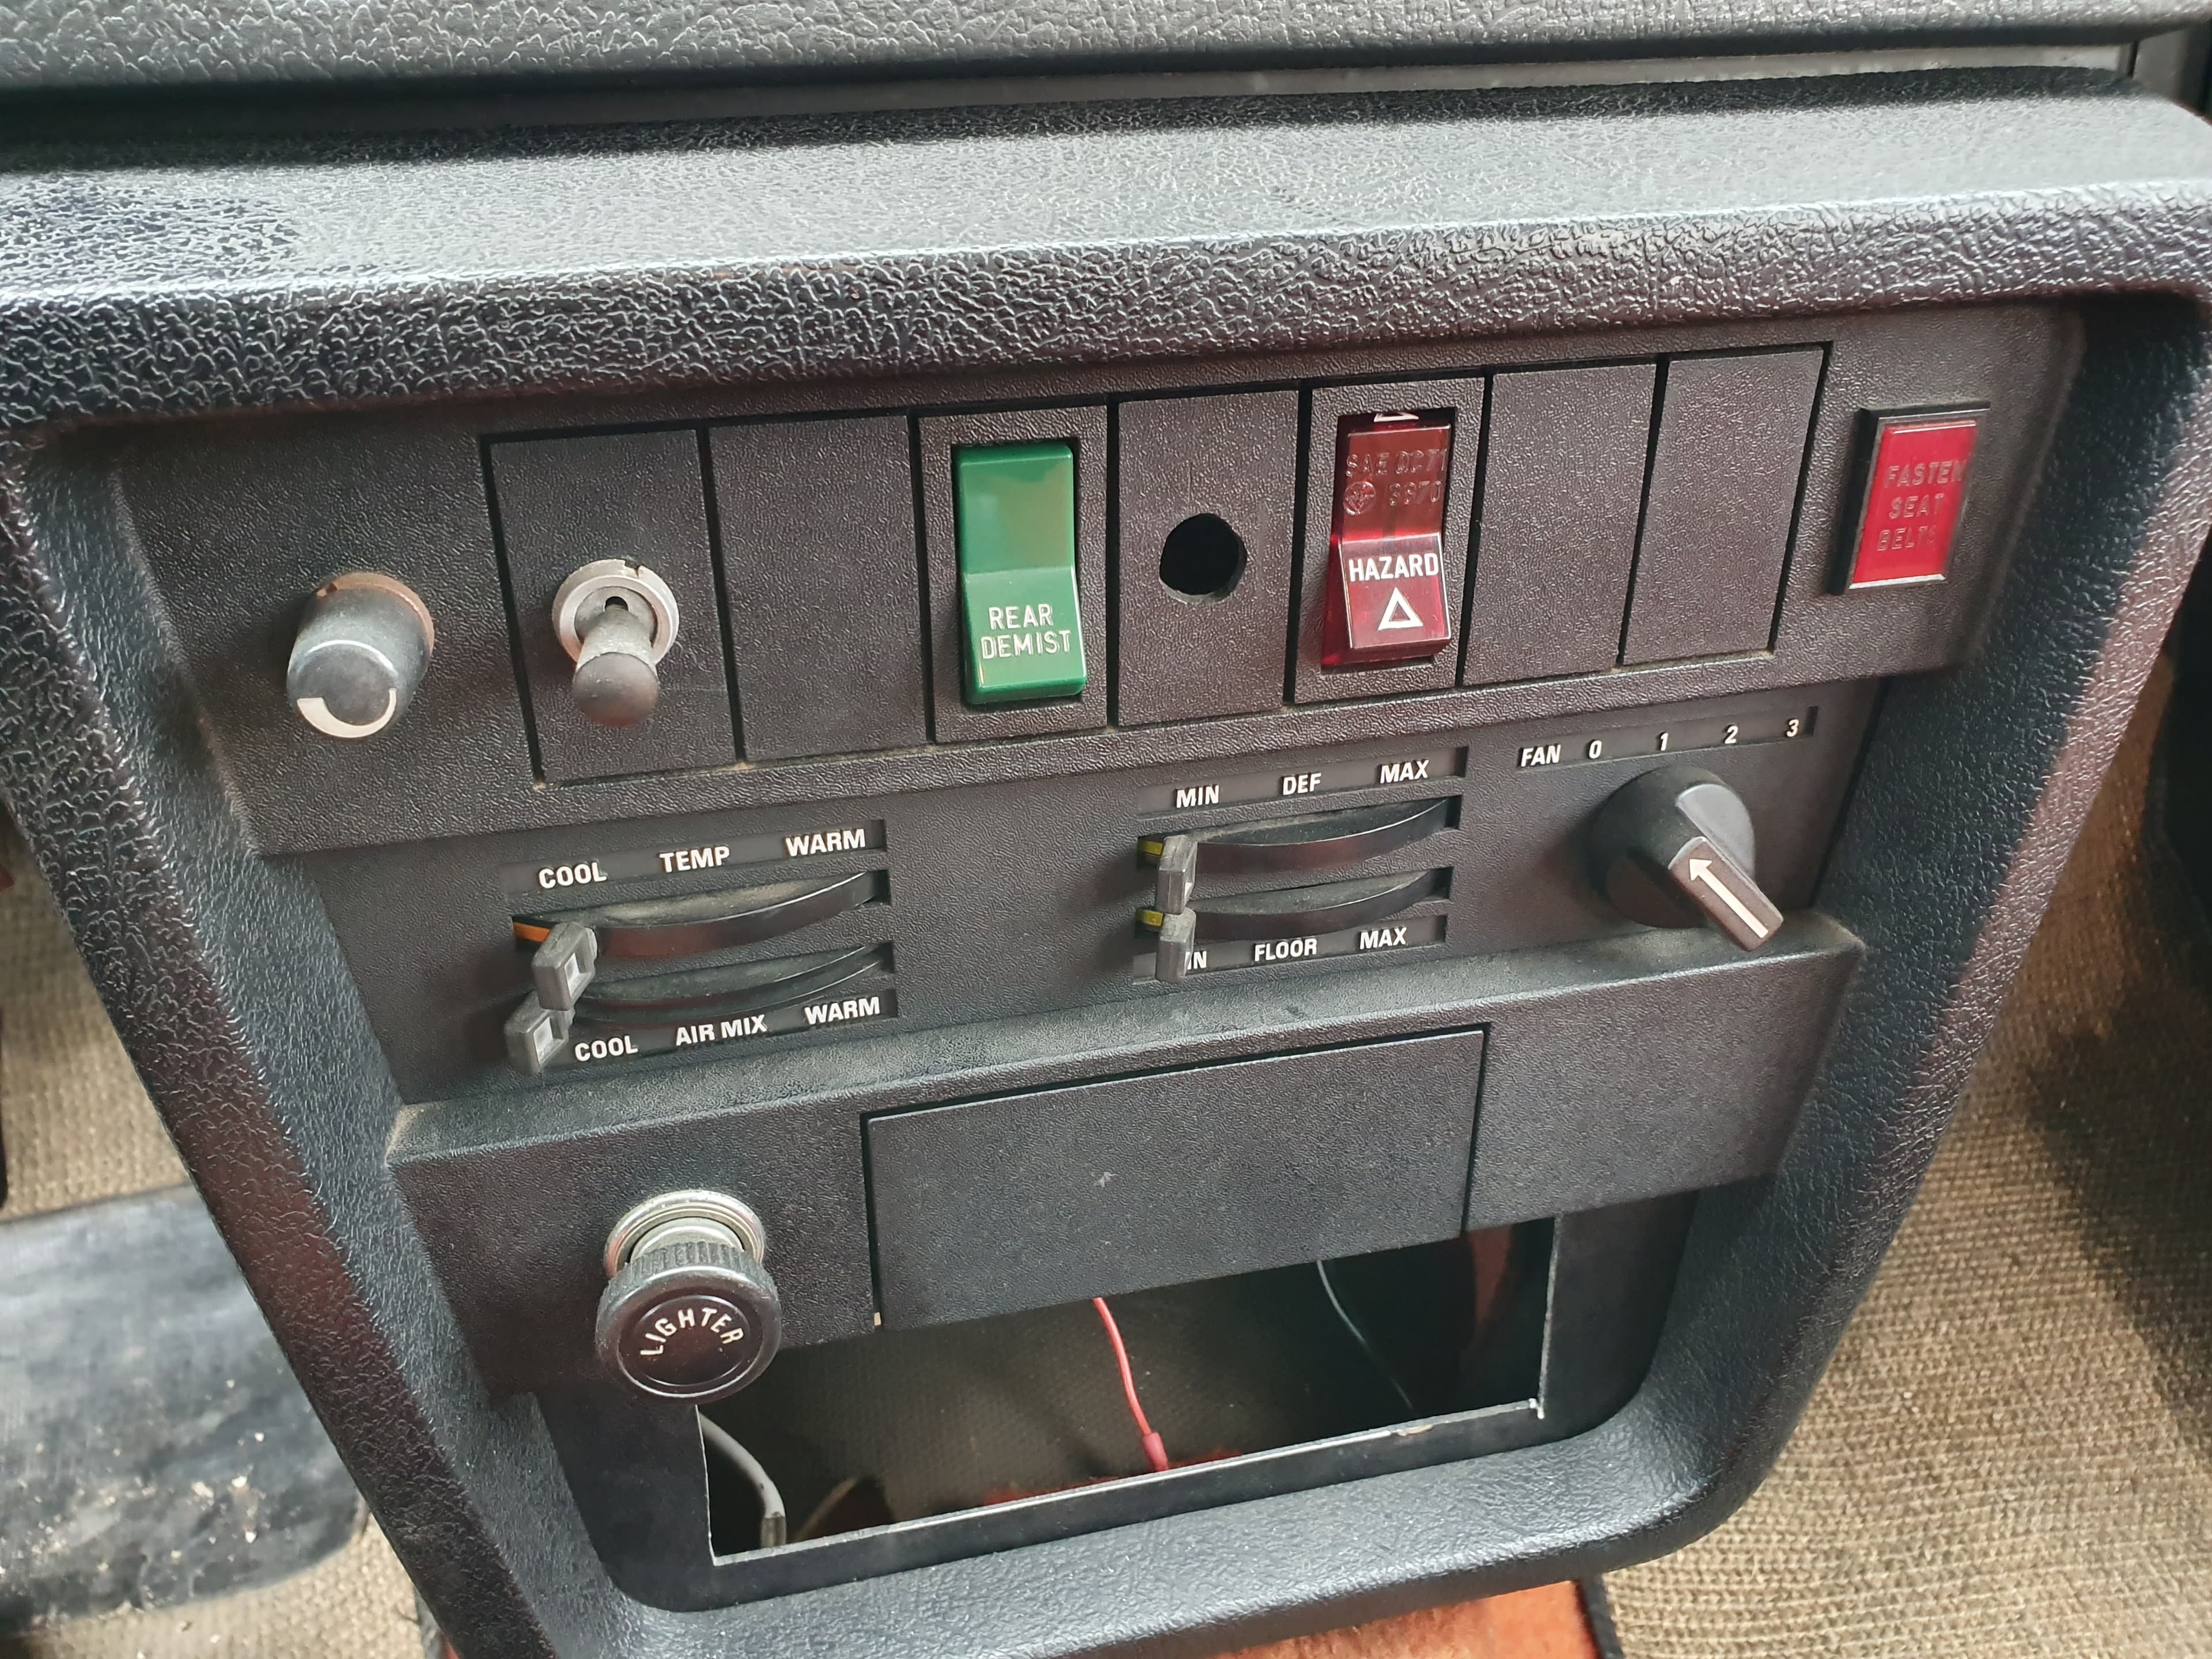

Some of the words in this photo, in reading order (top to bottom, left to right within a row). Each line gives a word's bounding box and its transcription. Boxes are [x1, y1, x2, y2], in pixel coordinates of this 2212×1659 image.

[1346, 452, 1390, 477] SAE
[1884, 460, 1967, 488] FASTEN
[1889, 493, 1945, 520] SEAT
[1877, 525, 1936, 551] BELTS
[1348, 552, 1440, 582] HAZARD
[988, 603, 1054, 630] REAR
[980, 630, 1071, 660] DEMIST
[1521, 744, 1561, 767] FAN
[1589, 740, 1602, 759] 0
[1661, 733, 1669, 751] 1
[1725, 725, 1738, 744] 2
[1787, 719, 1799, 737] 3
[1176, 785, 1219, 808] MIN
[1283, 772, 1321, 796] DEF
[1380, 760, 1429, 784] MAX
[539, 862, 607, 889] COOL
[659, 846, 730, 873] TEMP
[786, 828, 866, 857] WARM
[1255, 938, 1317, 962] FLOOR
[1359, 927, 1407, 950] MAX
[575, 1035, 638, 1061] COOL
[676, 1024, 715, 1046] AIR
[721, 1014, 767, 1038] MIX
[804, 997, 880, 1025] WARM
[640, 1306, 744, 1355] LIGHTER
